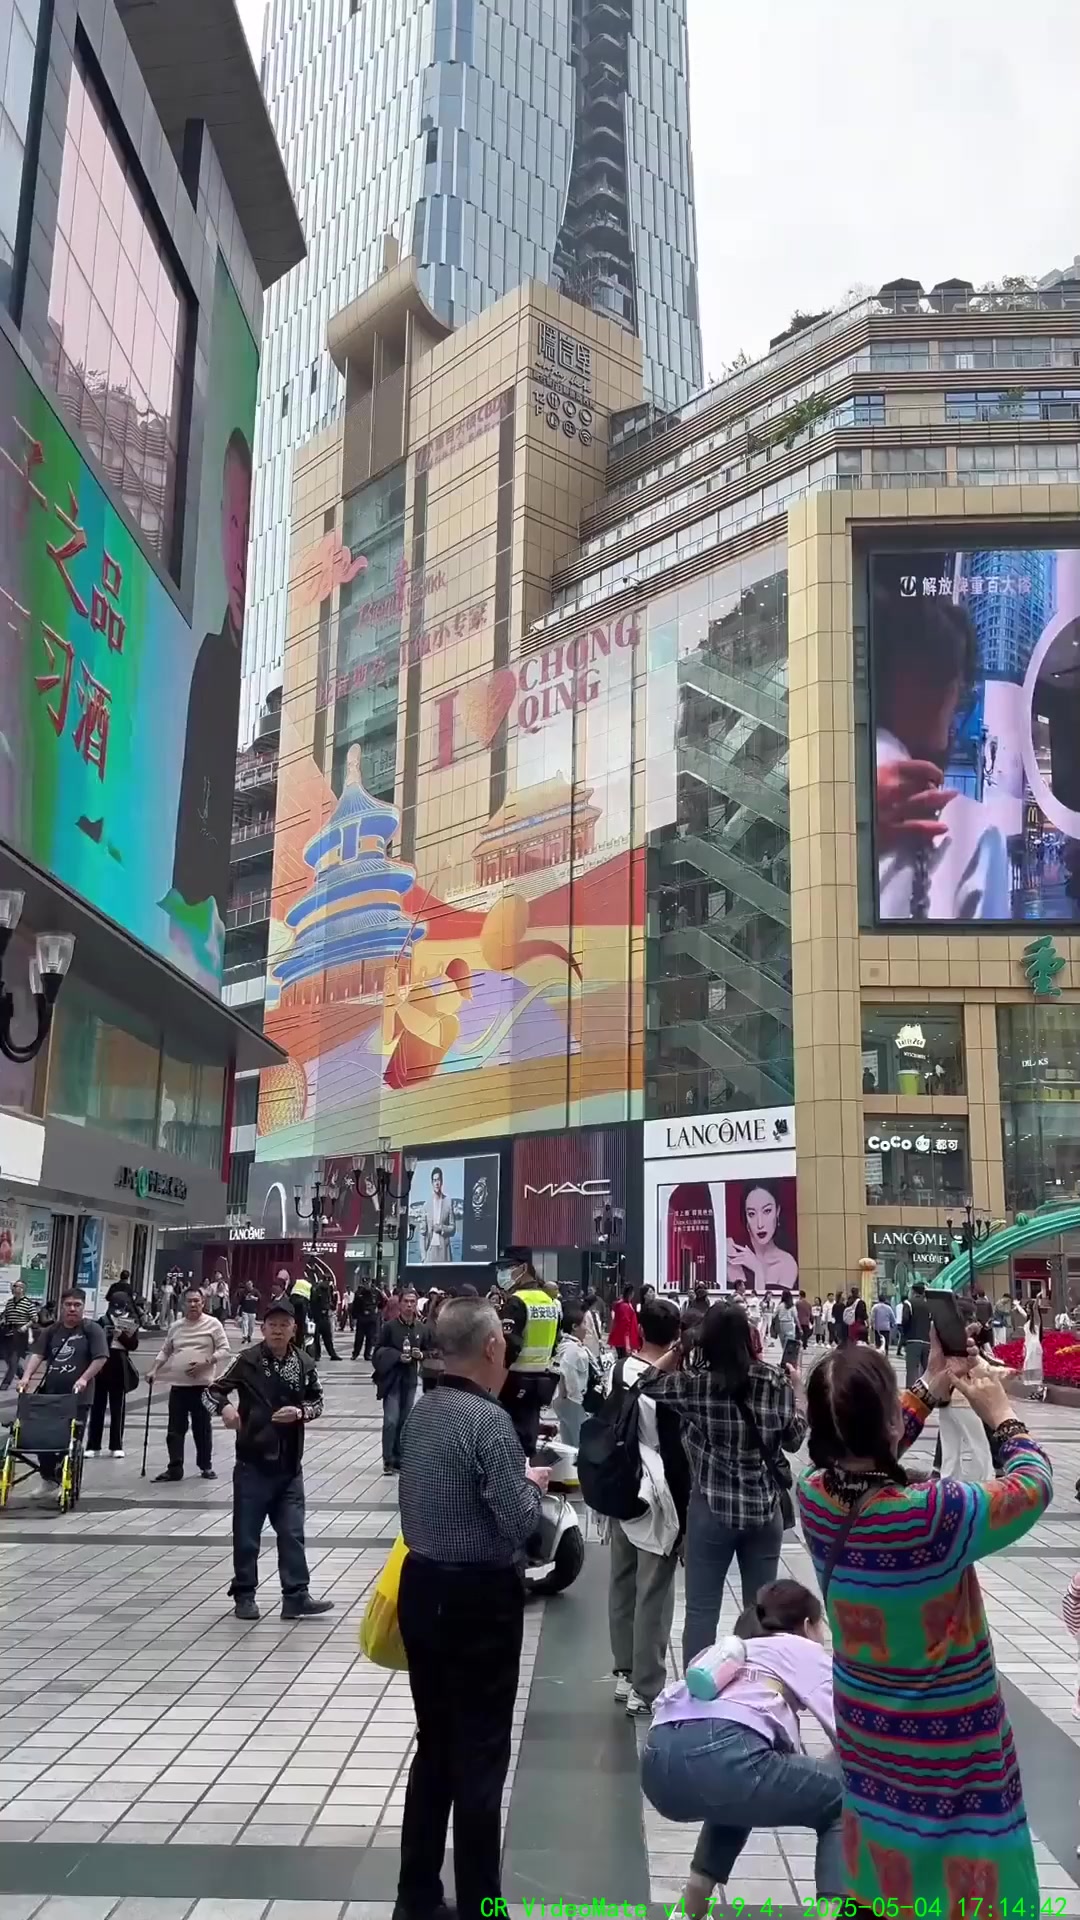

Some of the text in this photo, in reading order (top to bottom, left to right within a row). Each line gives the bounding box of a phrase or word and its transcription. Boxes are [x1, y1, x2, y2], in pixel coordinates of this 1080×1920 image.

[432, 612, 643, 773] I CHONG
[517, 668, 601, 734] QING
[667, 1118, 766, 1148] LANCÔME
[935, 1138, 959, 1151] 都可
[229, 1227, 266, 1240] LANCÔME
[873, 1231, 948, 1247] LANCÔME
